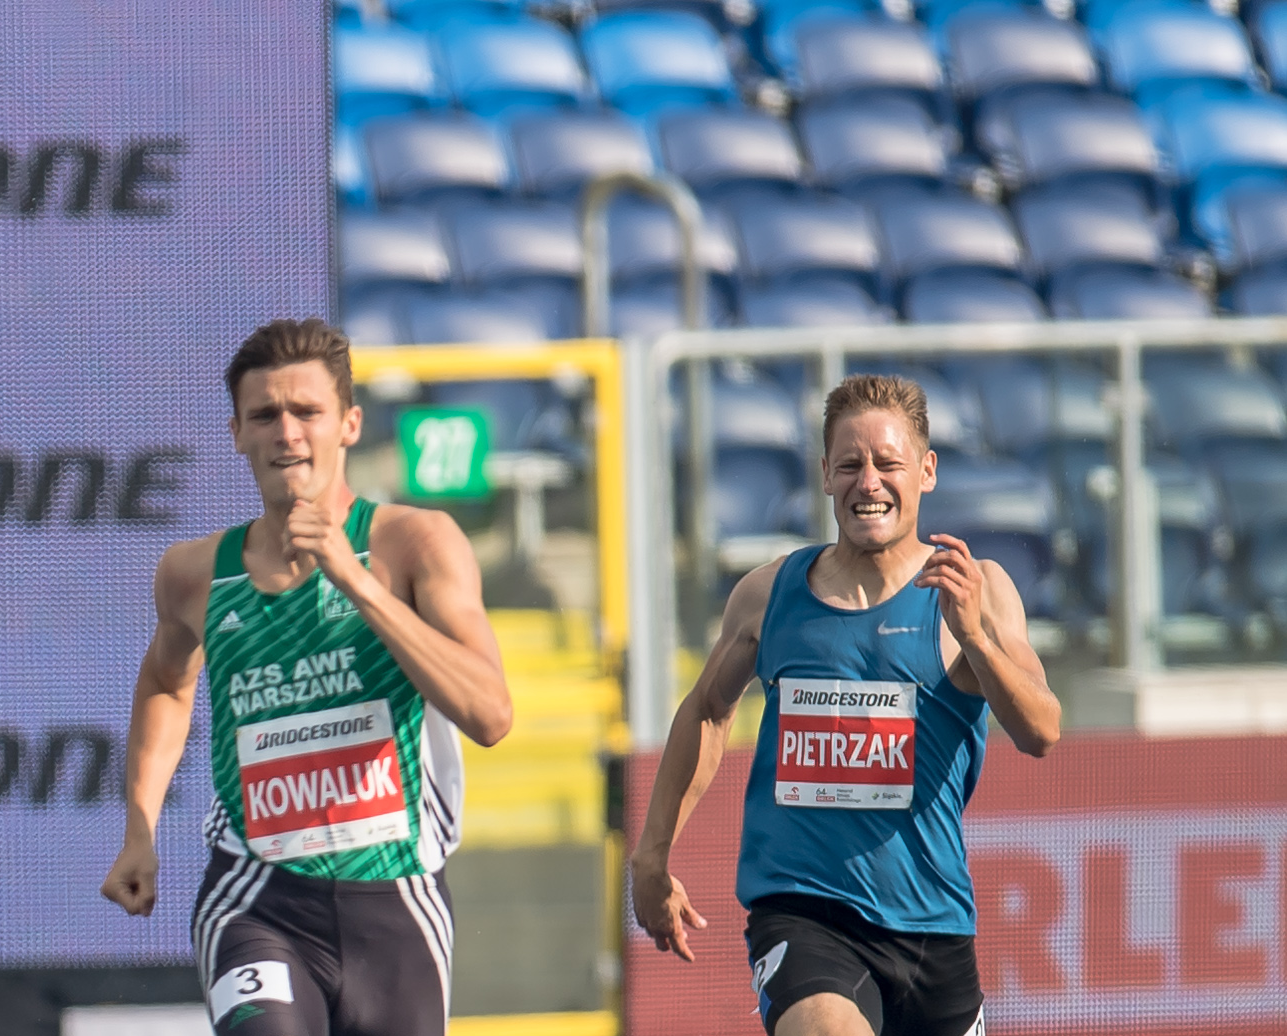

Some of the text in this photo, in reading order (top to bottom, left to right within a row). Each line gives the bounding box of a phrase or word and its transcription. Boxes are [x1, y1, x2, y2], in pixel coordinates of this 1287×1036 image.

[229, 647, 357, 696] AZS AWF
[230, 670, 365, 718] WARSZAWA
[792, 689, 900, 707] BRIDGESTONE
[255, 714, 375, 752] BRIDGESTONE
[782, 730, 909, 769] PIETRZAK
[247, 756, 399, 821] KOWALUK
[235, 967, 263, 994] 3
